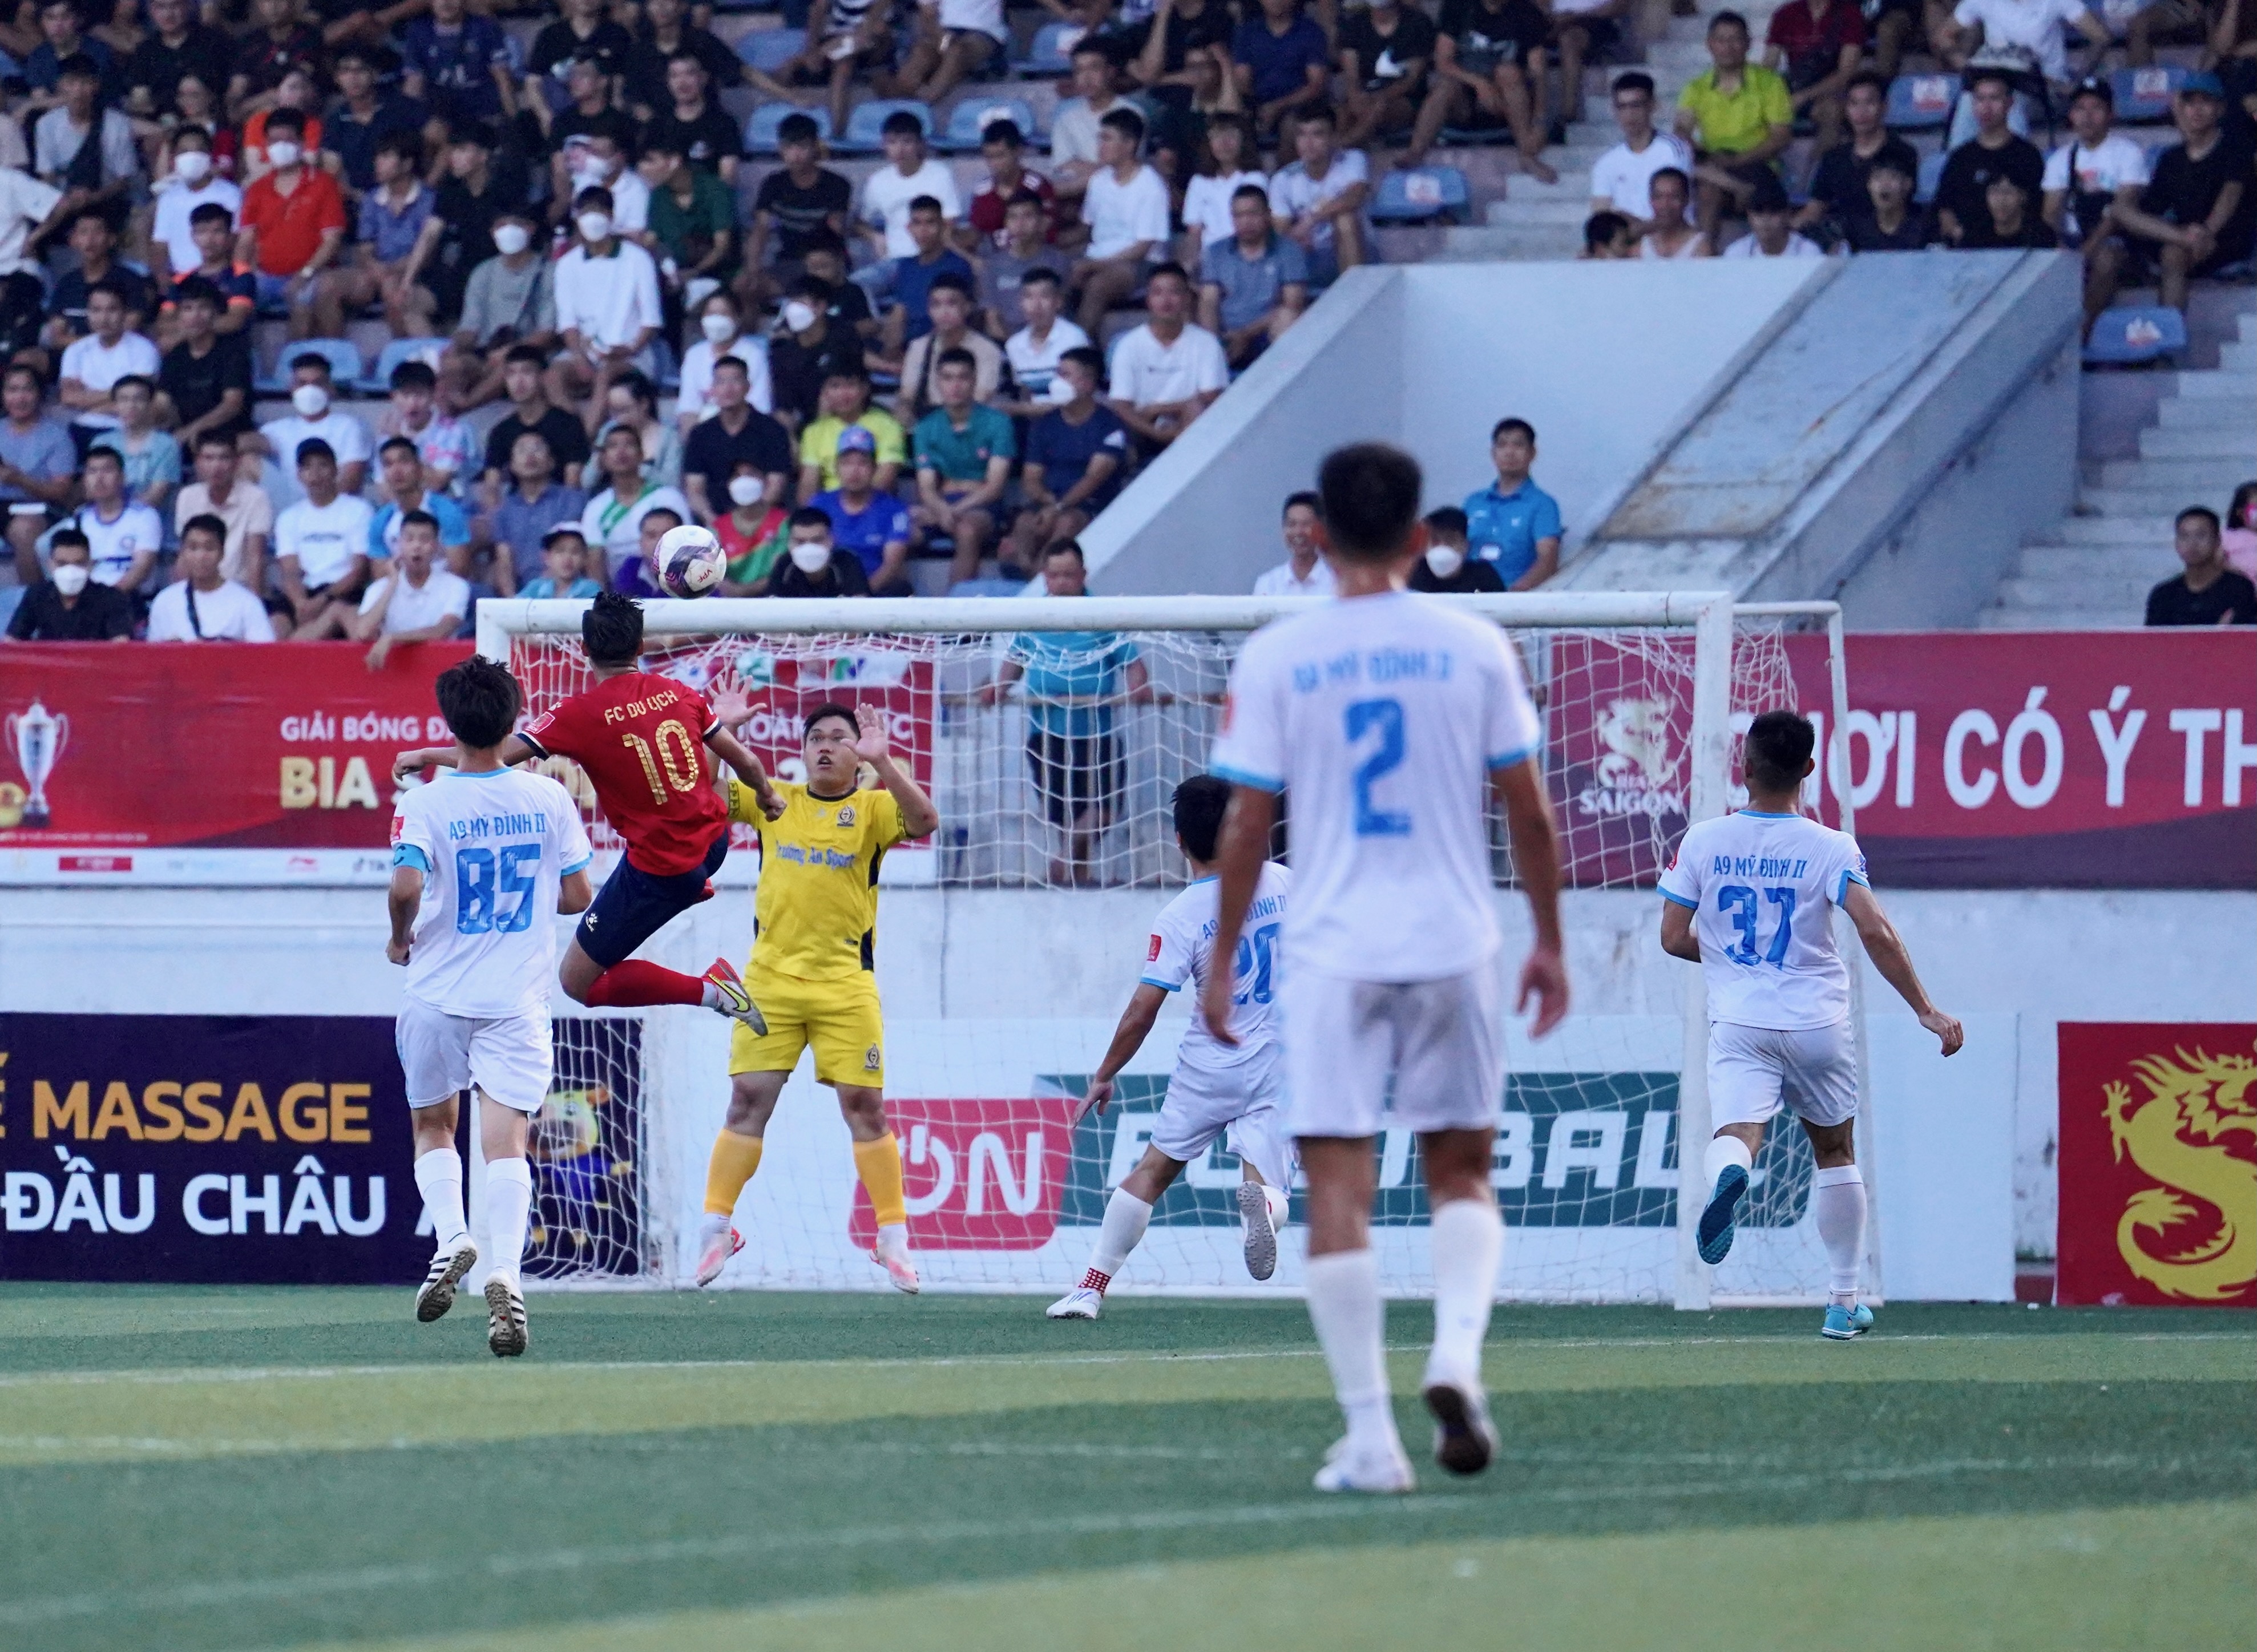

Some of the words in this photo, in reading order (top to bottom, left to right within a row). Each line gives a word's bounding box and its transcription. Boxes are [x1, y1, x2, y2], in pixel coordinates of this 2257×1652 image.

[697, 568, 713, 583] VPF
[280, 710, 336, 742] GIẢI
[343, 711, 419, 742] BÓNG
[604, 706, 625, 725] FC
[627, 700, 647, 718] DU
[622, 719, 699, 805] 10
[1344, 698, 1412, 835] 2
[1943, 685, 2064, 809] CÓ
[2088, 685, 2147, 807] Ý
[280, 756, 379, 809] BIA
[450, 821, 466, 840] A9
[494, 811, 531, 836] ĐÌNH
[456, 843, 541, 935] 85
[1714, 855, 1731, 875] A9
[1735, 855, 1756, 877] MỸ
[1760, 854, 1791, 878] ĐÌNH
[1718, 885, 1795, 971] 37
[33, 1080, 372, 1142] MASSAGE
[0, 1145, 156, 1234] ĐẦU
[182, 1154, 386, 1236] CHÂU
